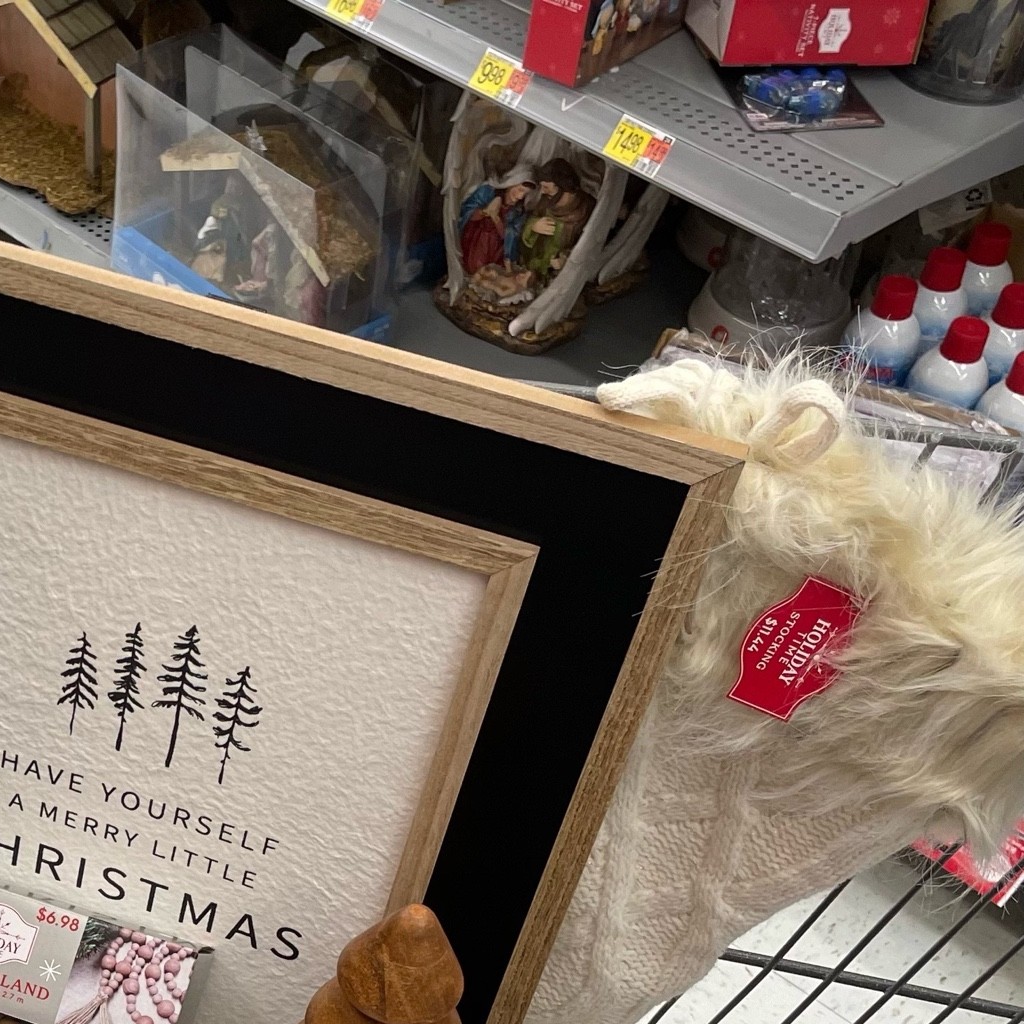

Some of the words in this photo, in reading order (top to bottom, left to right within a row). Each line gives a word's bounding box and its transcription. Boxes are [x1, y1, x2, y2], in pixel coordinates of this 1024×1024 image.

[747, 617, 778, 652] $11.44
[756, 611, 800, 671] STOCKING
[778, 632, 807, 665] TIME
[778, 618, 831, 686] HOLIDAY
[1, 750, 84, 793] HAVE
[101, 783, 279, 856] YOURSELF
[8, 793, 24, 811] A
[39, 802, 139, 848] MERRY
[152, 839, 257, 889] LITTLE
[36, 907, 80, 932] $6.98
